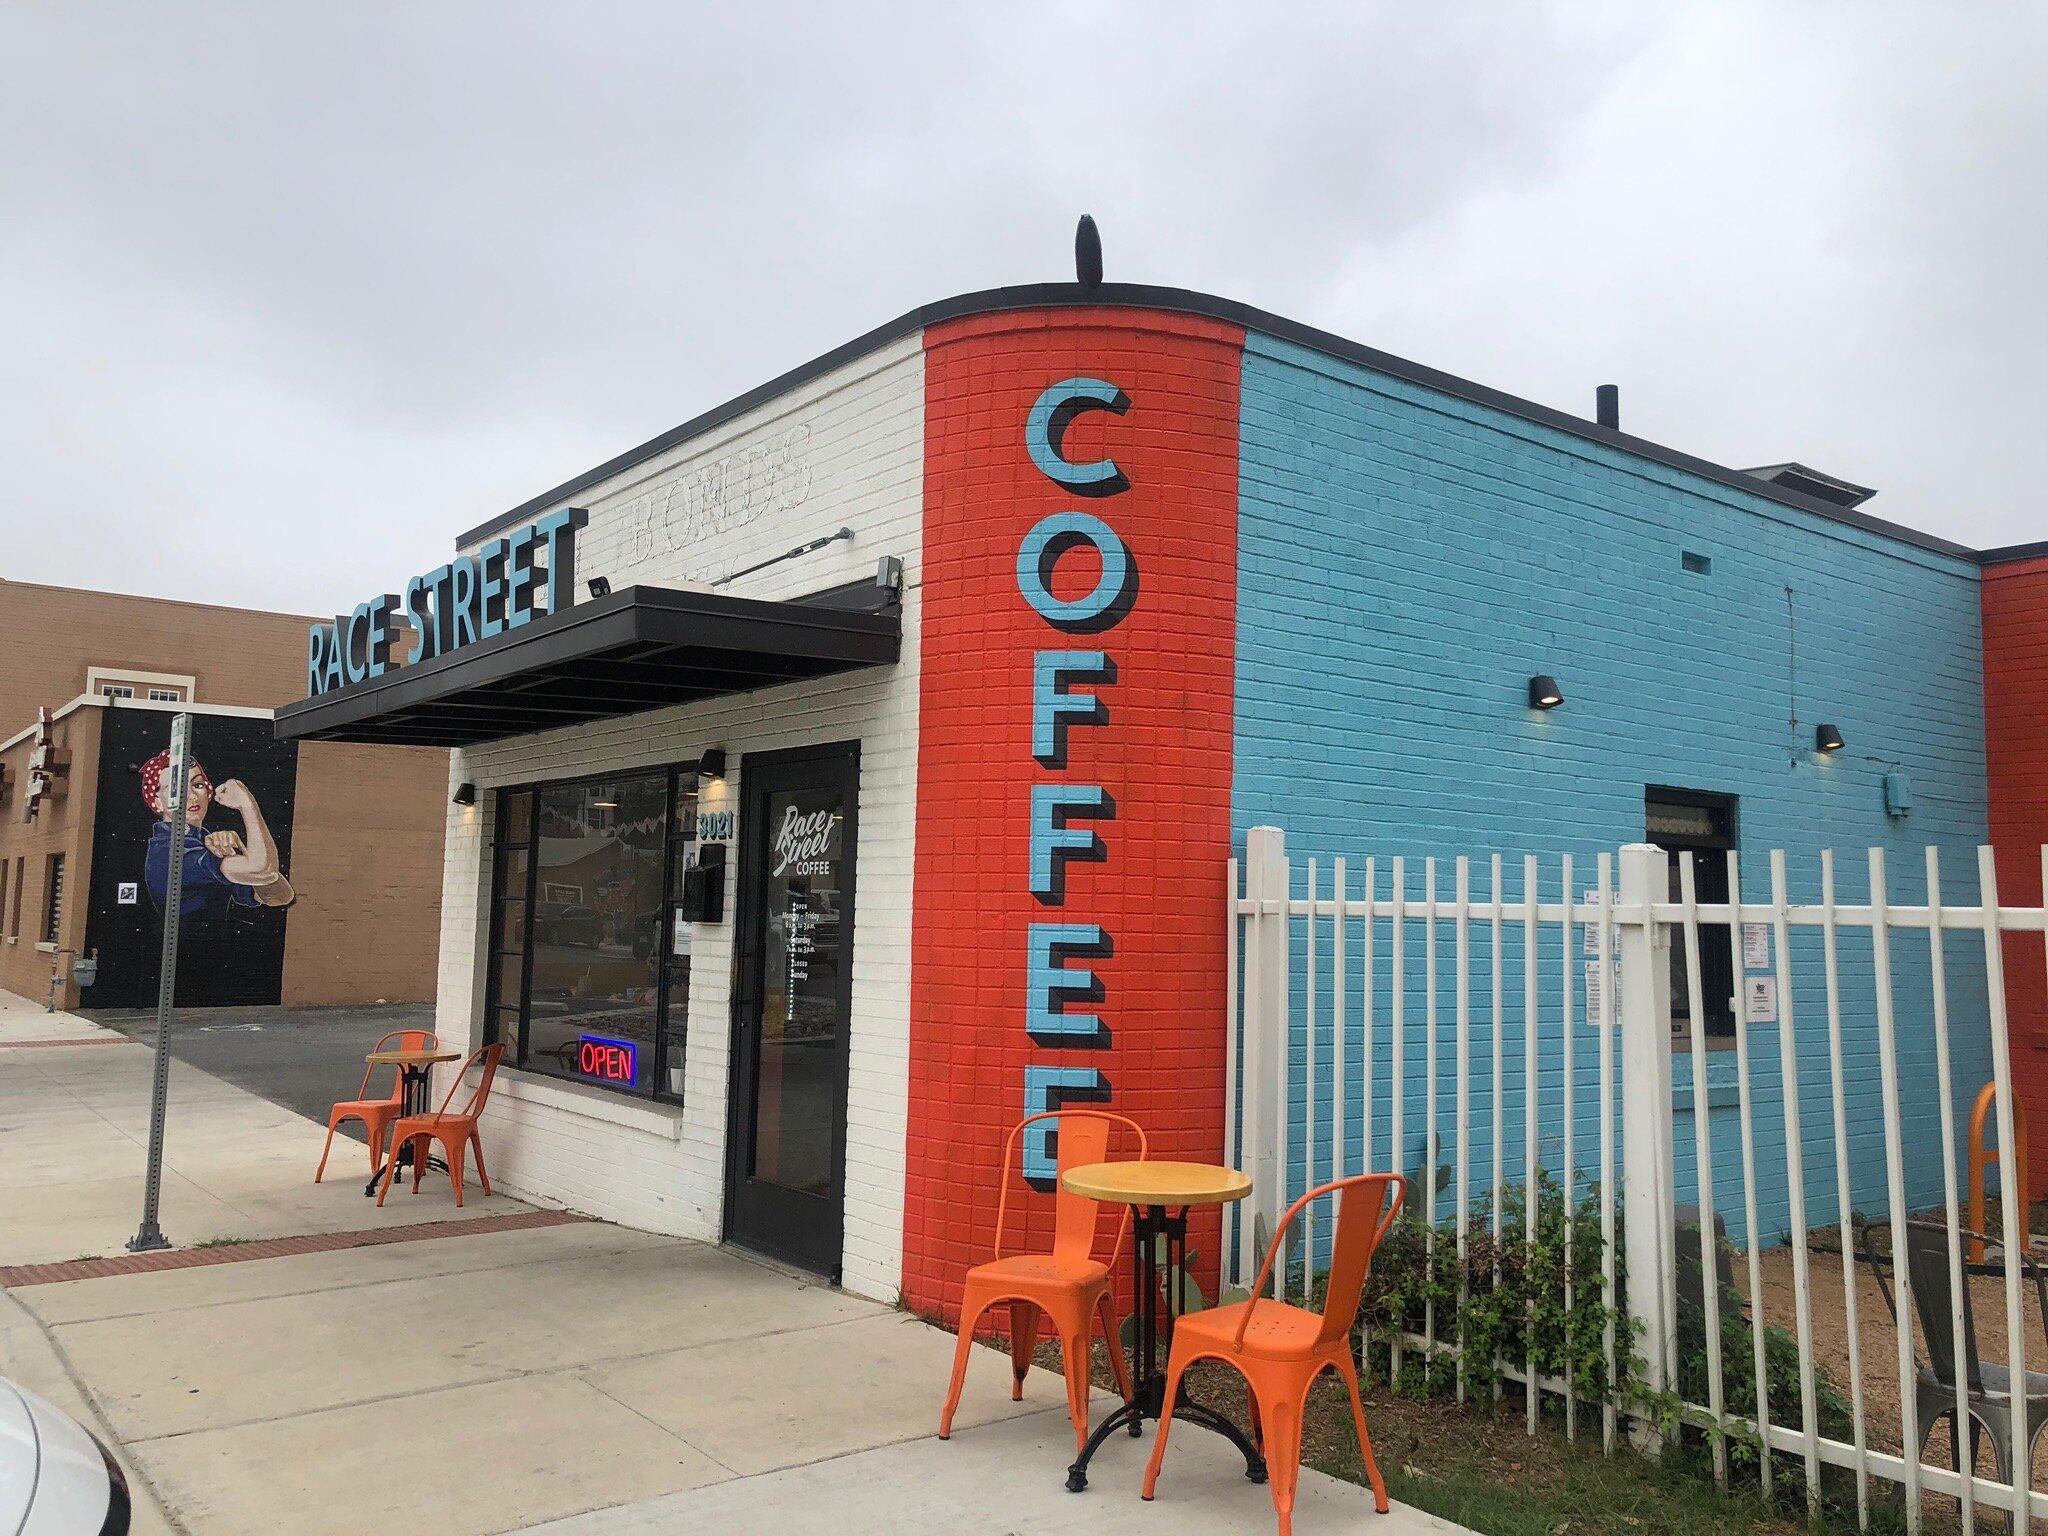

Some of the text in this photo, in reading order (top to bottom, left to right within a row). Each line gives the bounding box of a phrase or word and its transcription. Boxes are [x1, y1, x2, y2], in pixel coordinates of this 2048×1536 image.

[308, 507, 586, 698] RACE STREET
[1020, 376, 1138, 1194] COFFEE
[700, 811, 734, 841] 3021
[773, 812, 835, 877] Street
[775, 806, 826, 851] Race
[796, 861, 830, 876] COFFEE
[805, 911, 820, 922] Friday
[790, 935, 812, 945] Saturday
[581, 1042, 632, 1080] OPEN
